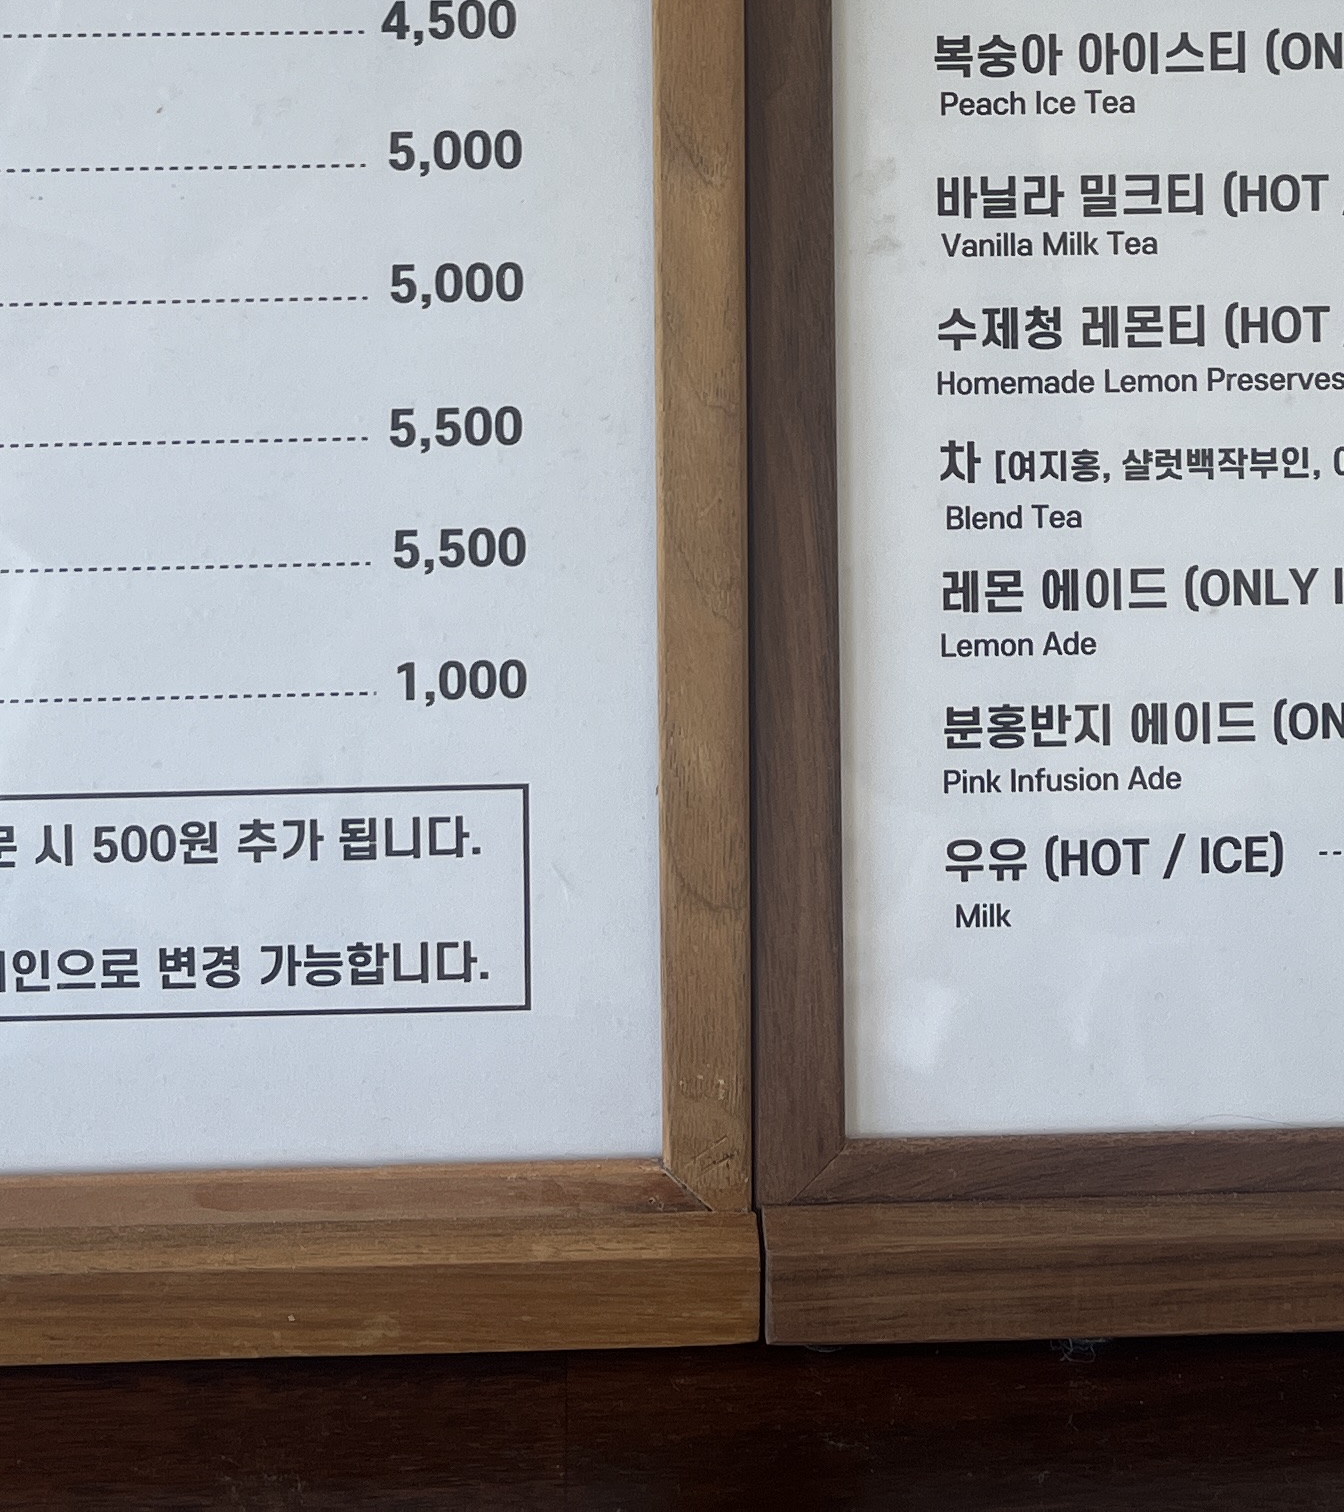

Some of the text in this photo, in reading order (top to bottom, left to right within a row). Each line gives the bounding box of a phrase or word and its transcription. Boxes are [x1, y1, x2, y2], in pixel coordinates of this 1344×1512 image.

[381, 0, 516, 46] 4,500
[934, 34, 1063, 78] 복숭아
[1079, 31, 1245, 75] 아이스티
[941, 91, 1025, 116] Peach
[1036, 91, 1075, 114] Ice
[1084, 90, 1135, 113] Tea
[938, 306, 1062, 351] 수제청
[1082, 305, 1205, 348] 레몬티
[1225, 302, 1330, 349] (HOT
[938, 369, 1094, 395] Homemade
[1105, 369, 1197, 393] Lemon
[940, 440, 981, 483] 차
[996, 449, 1110, 484] [여지홍,
[1122, 447, 1320, 481] 샬럿백작부인,
[947, 505, 1082, 530] Blend Tea
[397, 660, 526, 707] 1,000
[36, 824, 73, 866] 시
[94, 821, 218, 864] 500원
[238, 819, 324, 863] 추가
[339, 816, 480, 861] 됩니다.
[159, 946, 240, 989] 변경
[261, 941, 488, 987] 가능합니다.
